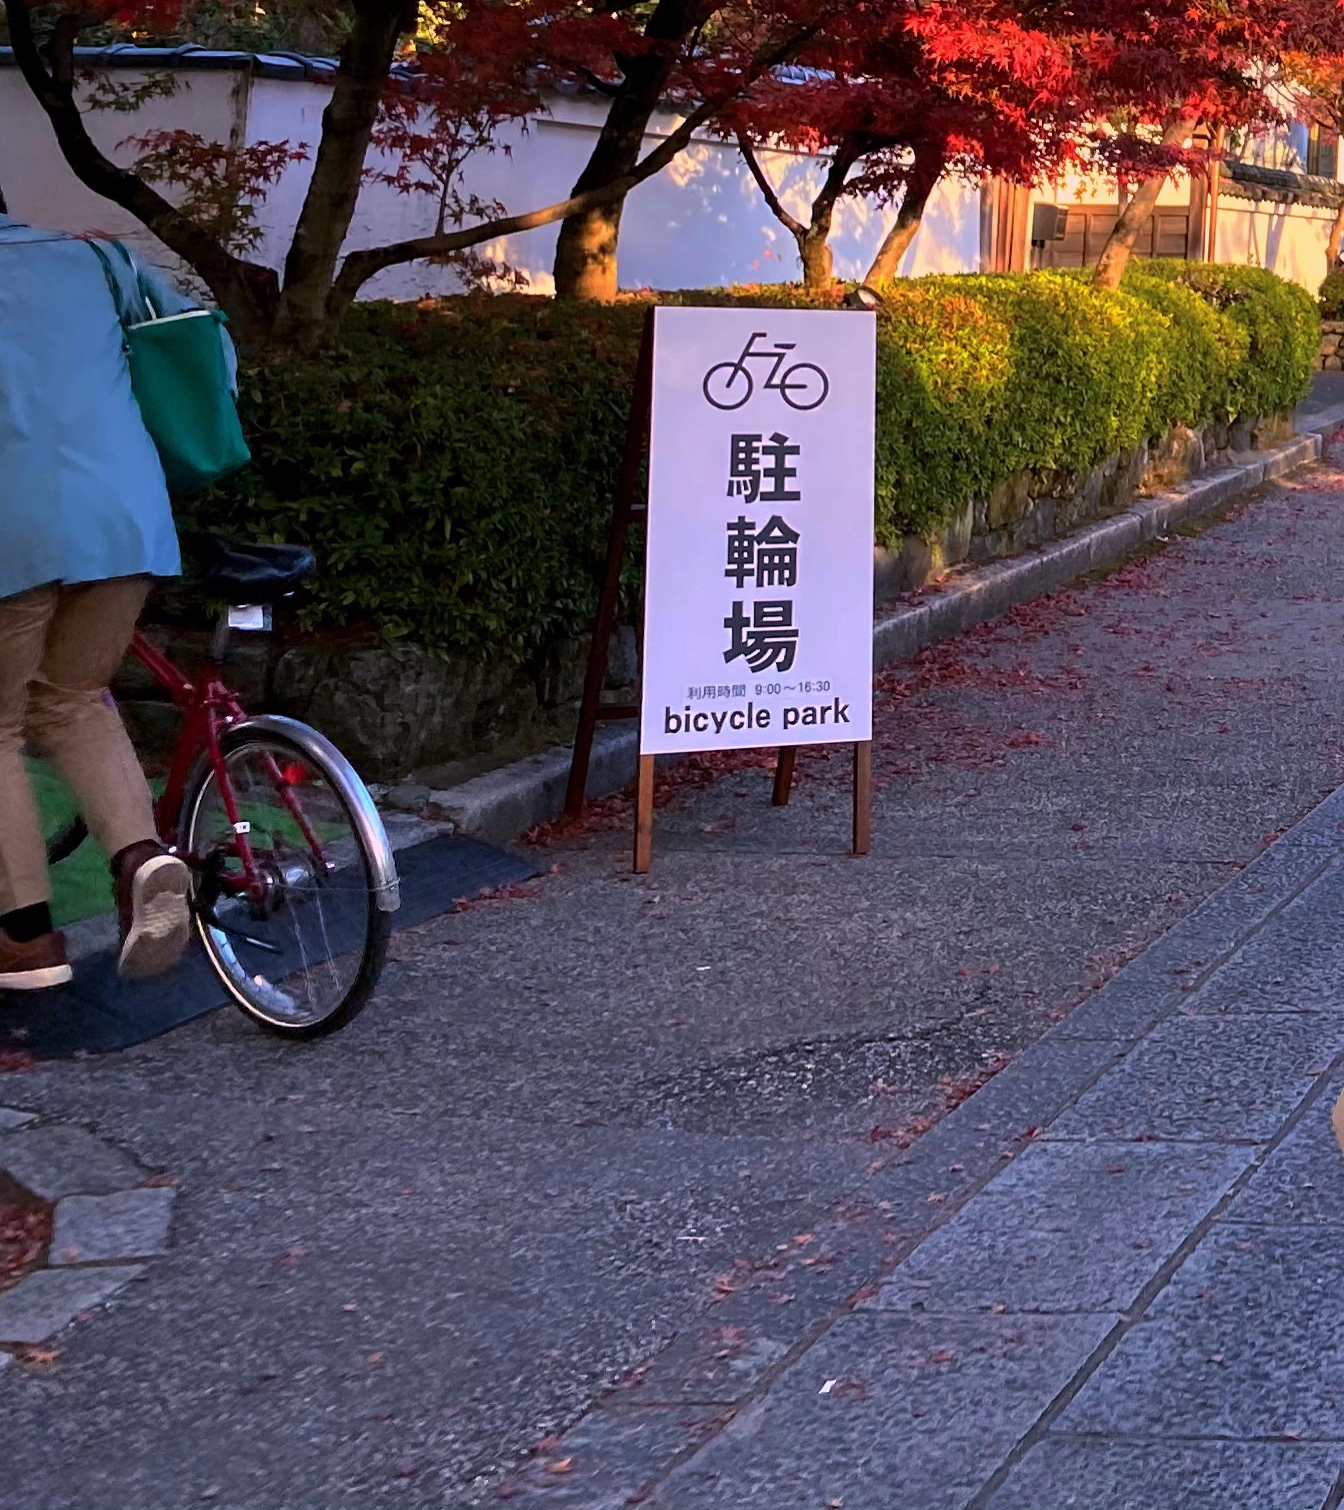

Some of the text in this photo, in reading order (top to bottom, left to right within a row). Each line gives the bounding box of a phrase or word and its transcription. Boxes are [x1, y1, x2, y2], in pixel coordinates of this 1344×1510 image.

[723, 431, 801, 673] 駐輪場
[687, 684, 746, 700] 利用時間
[664, 697, 850, 734] bicycle park
